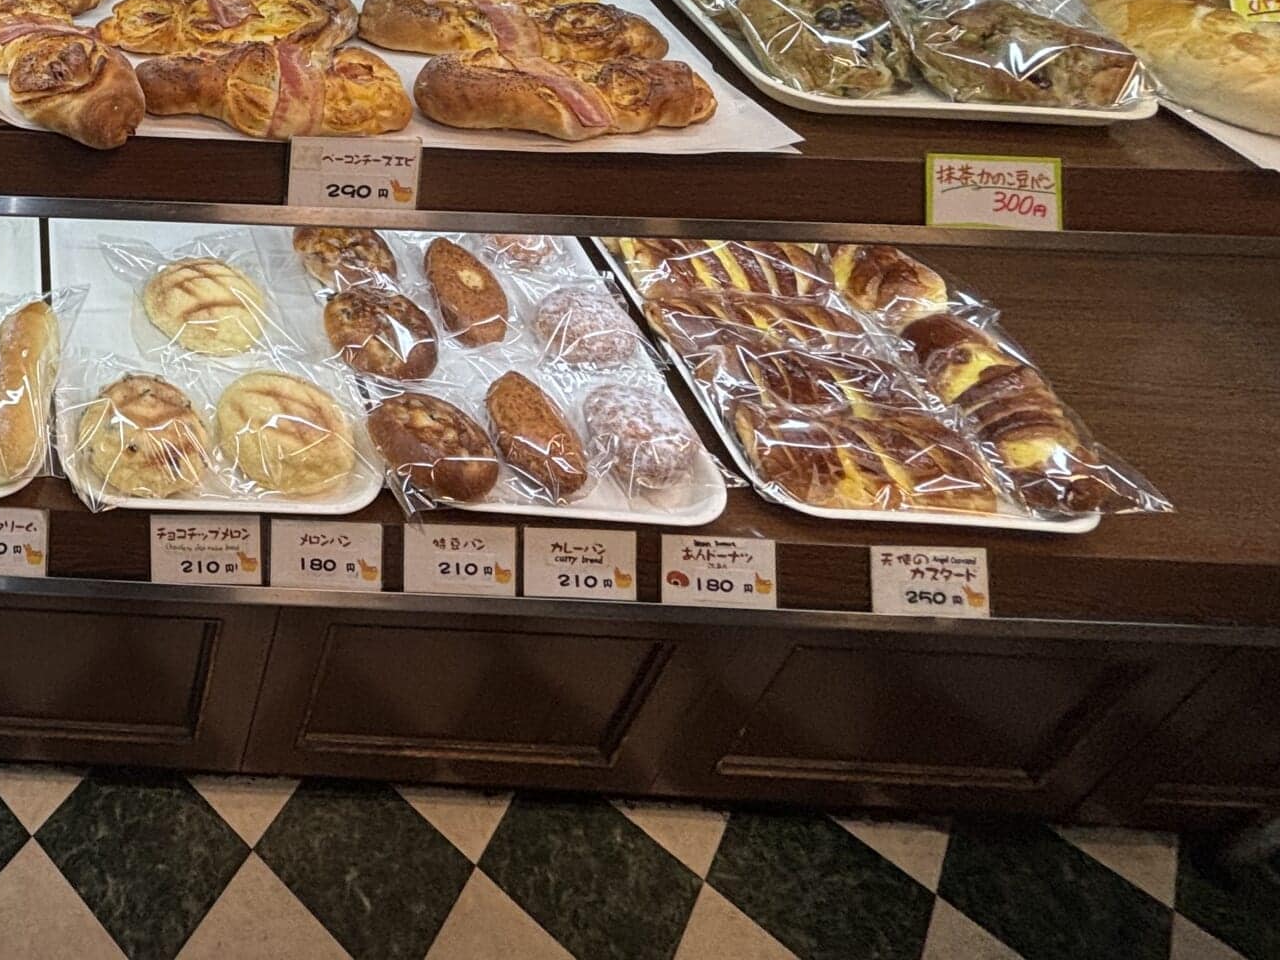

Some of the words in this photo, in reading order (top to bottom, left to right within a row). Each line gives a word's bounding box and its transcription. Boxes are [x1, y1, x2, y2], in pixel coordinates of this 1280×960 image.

[992, 191, 1047, 217] 300円
[682, 547, 753, 563] あんドーナツ
[881, 553, 929, 566] 天使の
